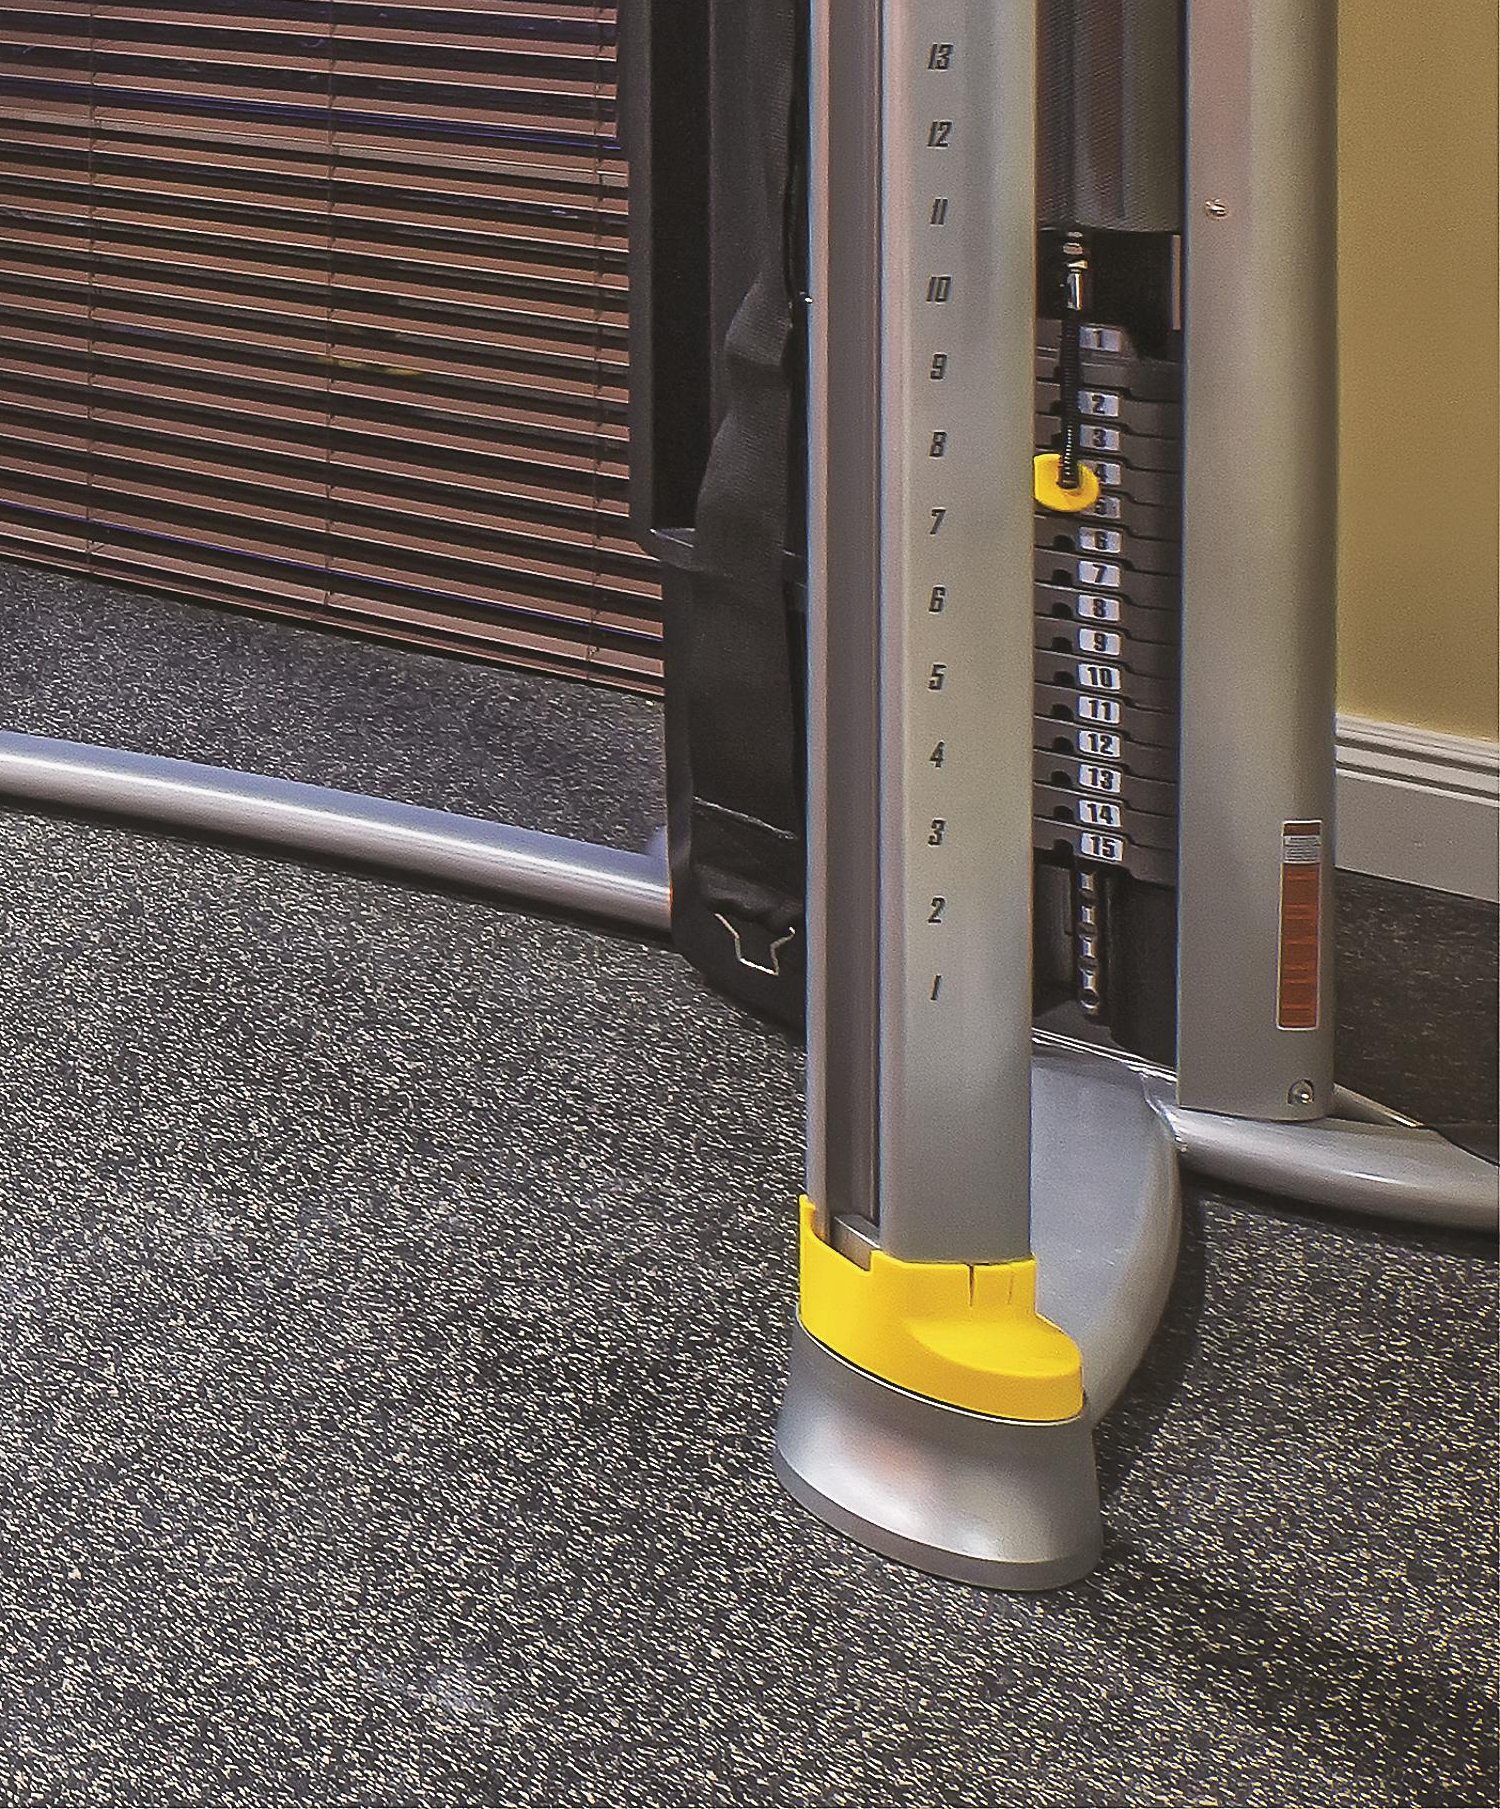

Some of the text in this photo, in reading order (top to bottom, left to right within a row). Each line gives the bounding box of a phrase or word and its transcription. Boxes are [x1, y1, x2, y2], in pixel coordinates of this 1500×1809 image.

[927, 43, 954, 70] 13
[926, 121, 953, 148] 12
[930, 198, 949, 226] 11
[925, 276, 952, 303] 10
[1092, 330, 1103, 349] 1
[929, 353, 948, 380] 9
[1091, 394, 1105, 414] 2
[929, 431, 948, 458] 8
[1093, 428, 1106, 447] 3
[929, 508, 947, 535] 7
[1094, 530, 1108, 551] 6
[1092, 563, 1106, 583] 7
[928, 585, 946, 613] 6
[1093, 598, 1107, 618] 8
[1094, 632, 1108, 653] 9
[927, 664, 947, 691] 5
[1087, 666, 1113, 687] 10
[1088, 699, 1112, 721] 11
[929, 741, 945, 768] 4
[1088, 733, 1114, 755] 12
[1087, 767, 1114, 790] 13
[1087, 802, 1114, 825] 14
[927, 819, 946, 846] 3
[1090, 836, 1116, 858] 15
[927, 897, 946, 924] 2
[930, 975, 942, 1001] 1
